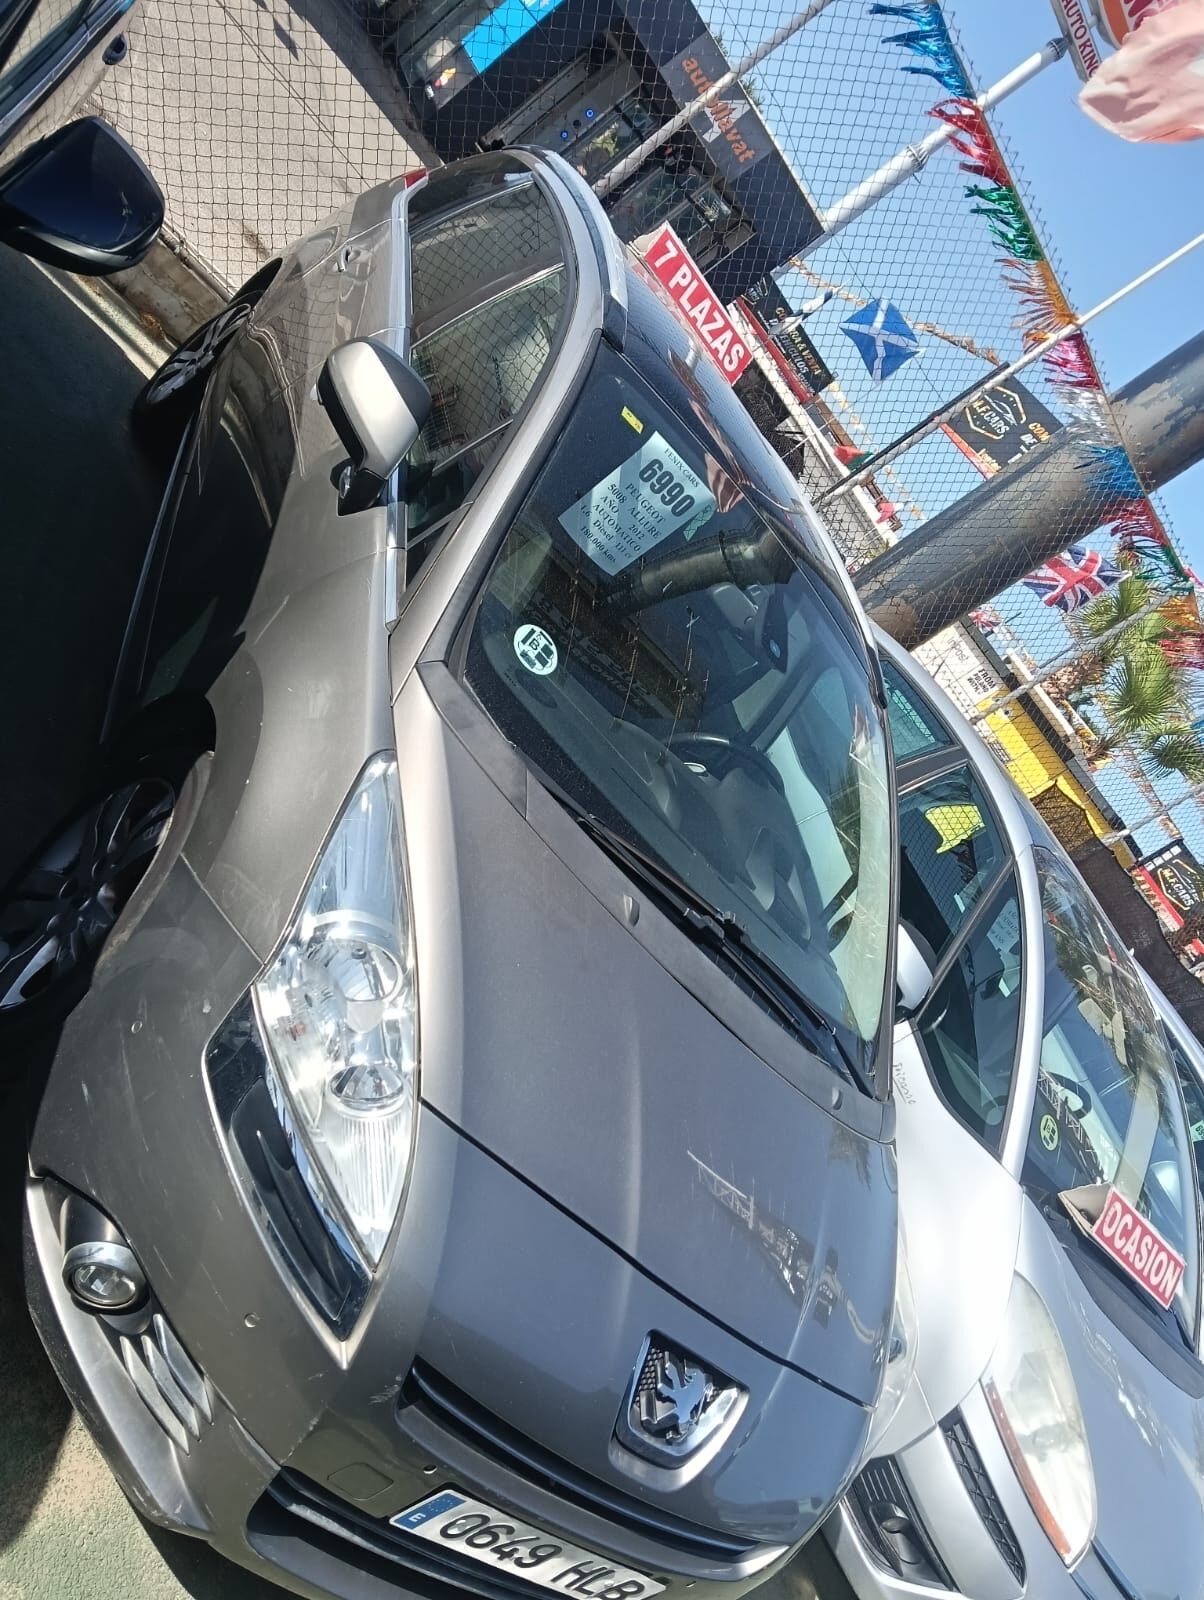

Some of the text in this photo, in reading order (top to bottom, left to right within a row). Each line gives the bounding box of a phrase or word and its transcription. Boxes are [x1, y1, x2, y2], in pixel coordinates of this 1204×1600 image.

[1061, 0, 1087, 40] AUTO
[654, 240, 745, 372] 7 PLAZAS
[775, 307, 801, 344] CORA
[802, 349, 822, 375] VENTA
[779, 331, 809, 373] EHICULOS
[1020, 433, 1038, 445] DE
[1028, 422, 1051, 442] COM
[639, 459, 695, 517] 6990
[682, 468, 700, 488] CARS
[600, 496, 645, 540] AÑO 2012
[607, 483, 661, 539] 5008 ALLURE
[625, 483, 665, 524] PEUGEOT
[592, 504, 641, 552] AUTOMATICO
[593, 519, 614, 541] Diesel
[978, 668, 996, 689] FROM
[1103, 1202, 1180, 1298] OCASION
[410, 1512, 426, 1523] E
[439, 1513, 645, 1600] 0649 HLB
